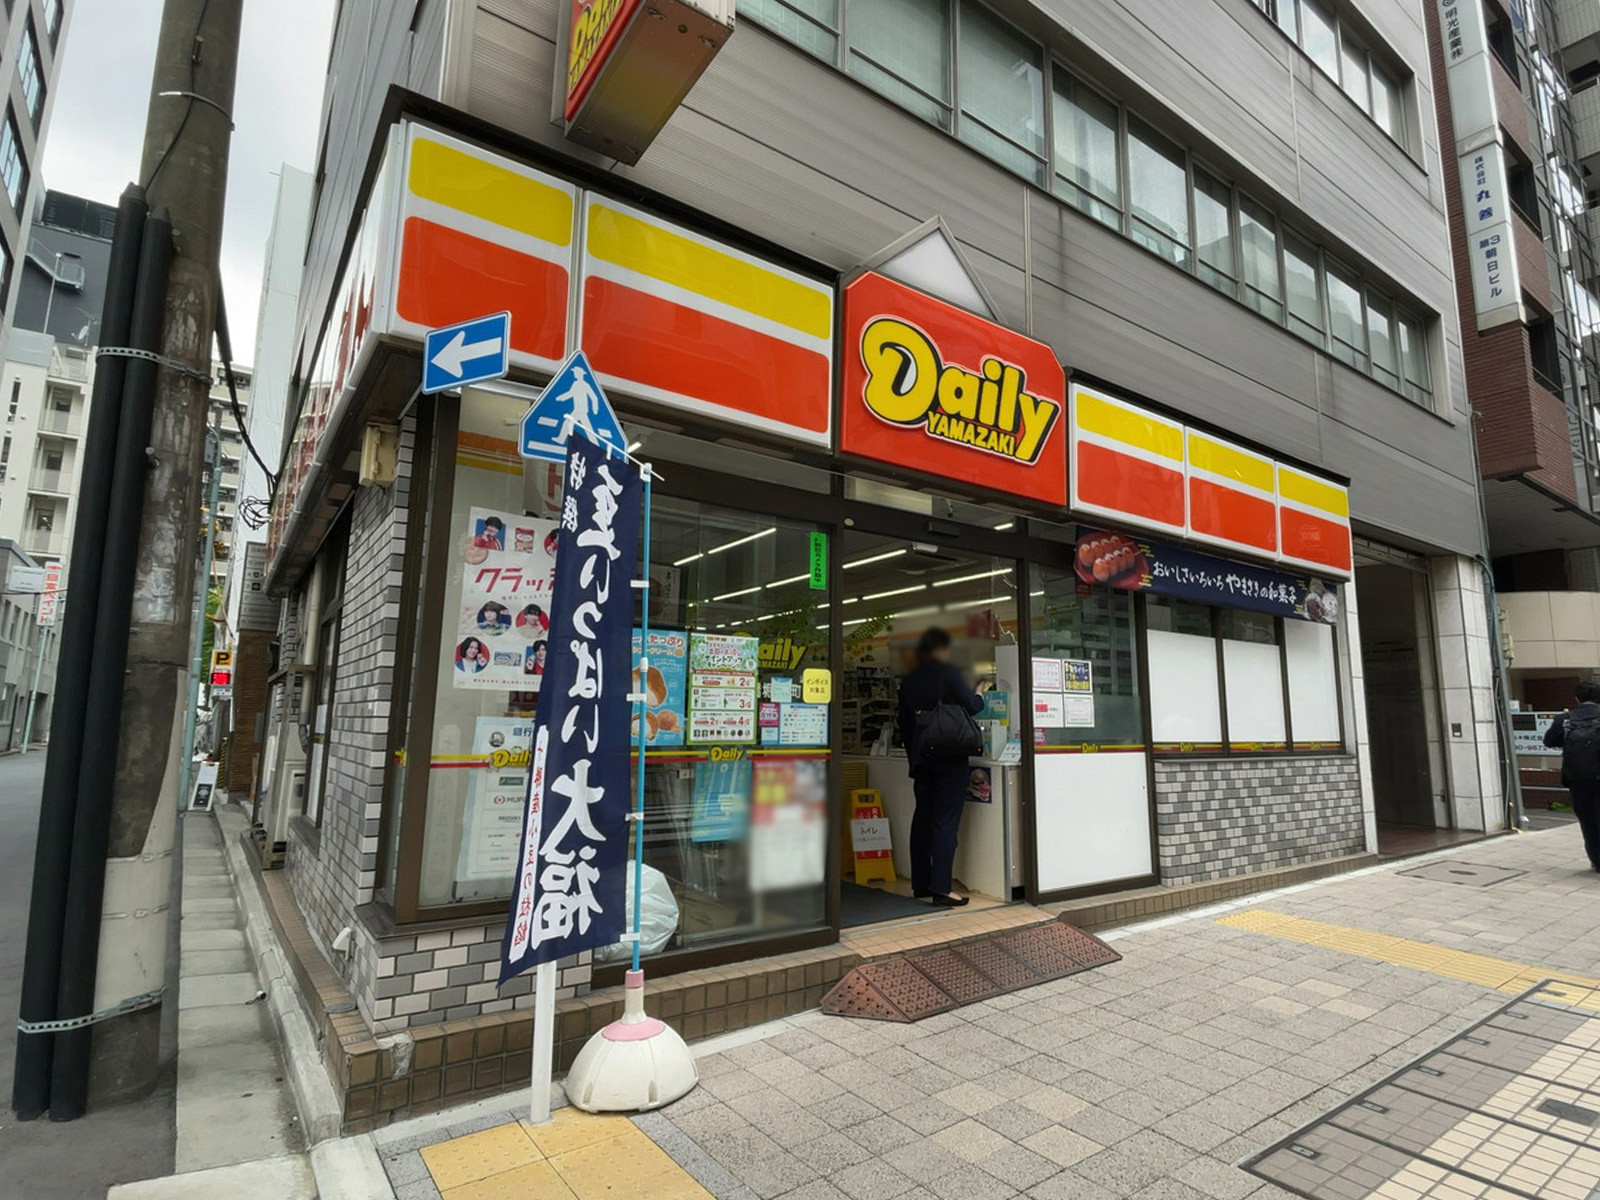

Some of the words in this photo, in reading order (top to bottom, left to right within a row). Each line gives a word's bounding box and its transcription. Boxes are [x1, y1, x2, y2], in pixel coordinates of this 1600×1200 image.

[1479, 234, 1502, 299] 第3朝日ビル
[862, 318, 1060, 463] Daily
[927, 411, 1016, 457] YAMAZAKI
[216, 652, 229, 665] P
[759, 637, 807, 669] aily
[711, 747, 743, 762] Daily
